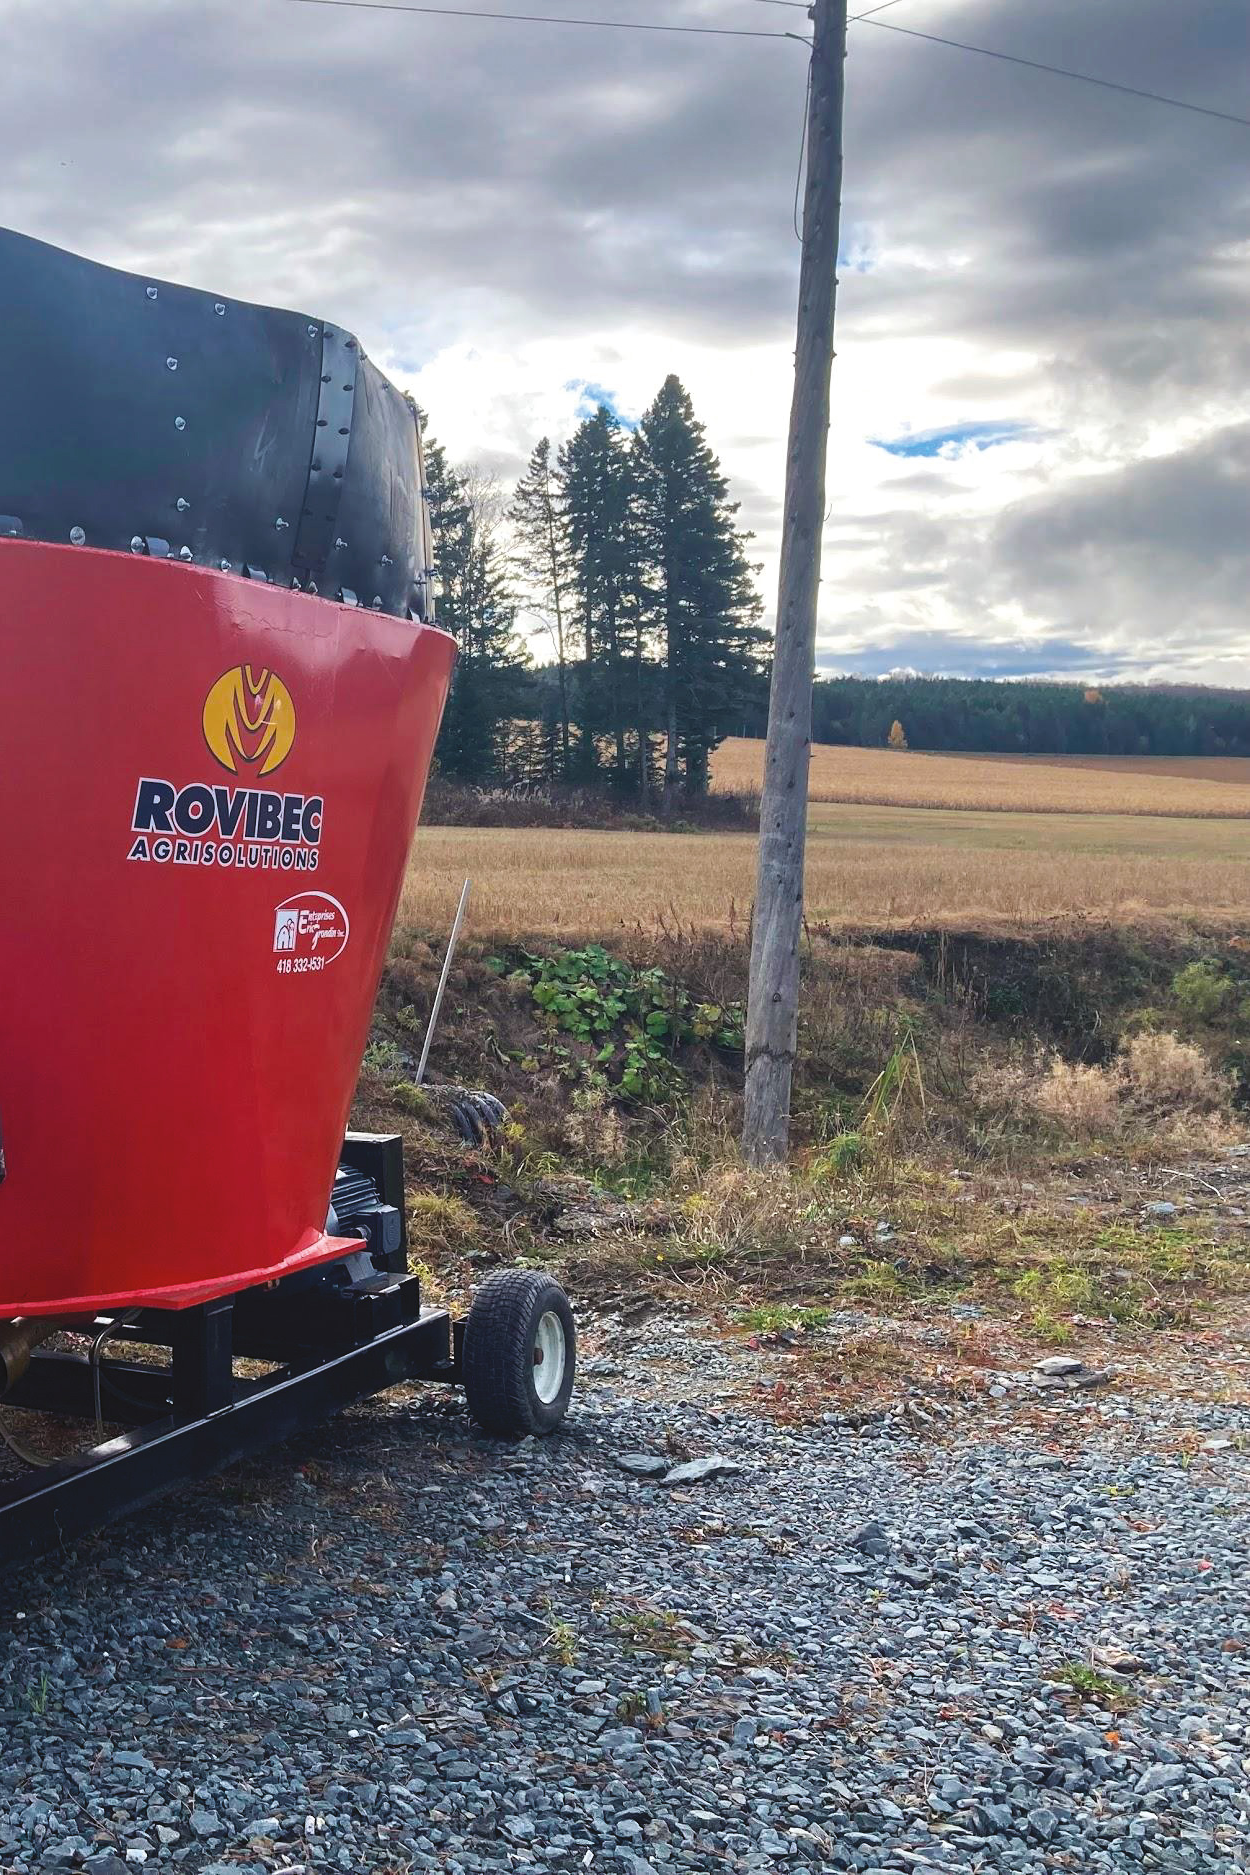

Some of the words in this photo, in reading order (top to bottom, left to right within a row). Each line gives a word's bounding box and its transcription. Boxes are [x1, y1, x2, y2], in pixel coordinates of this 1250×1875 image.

[131, 777, 324, 845] ROVIBEC
[126, 836, 319, 871] AGRISOLUTIONS
[276, 958, 292, 974] 418
